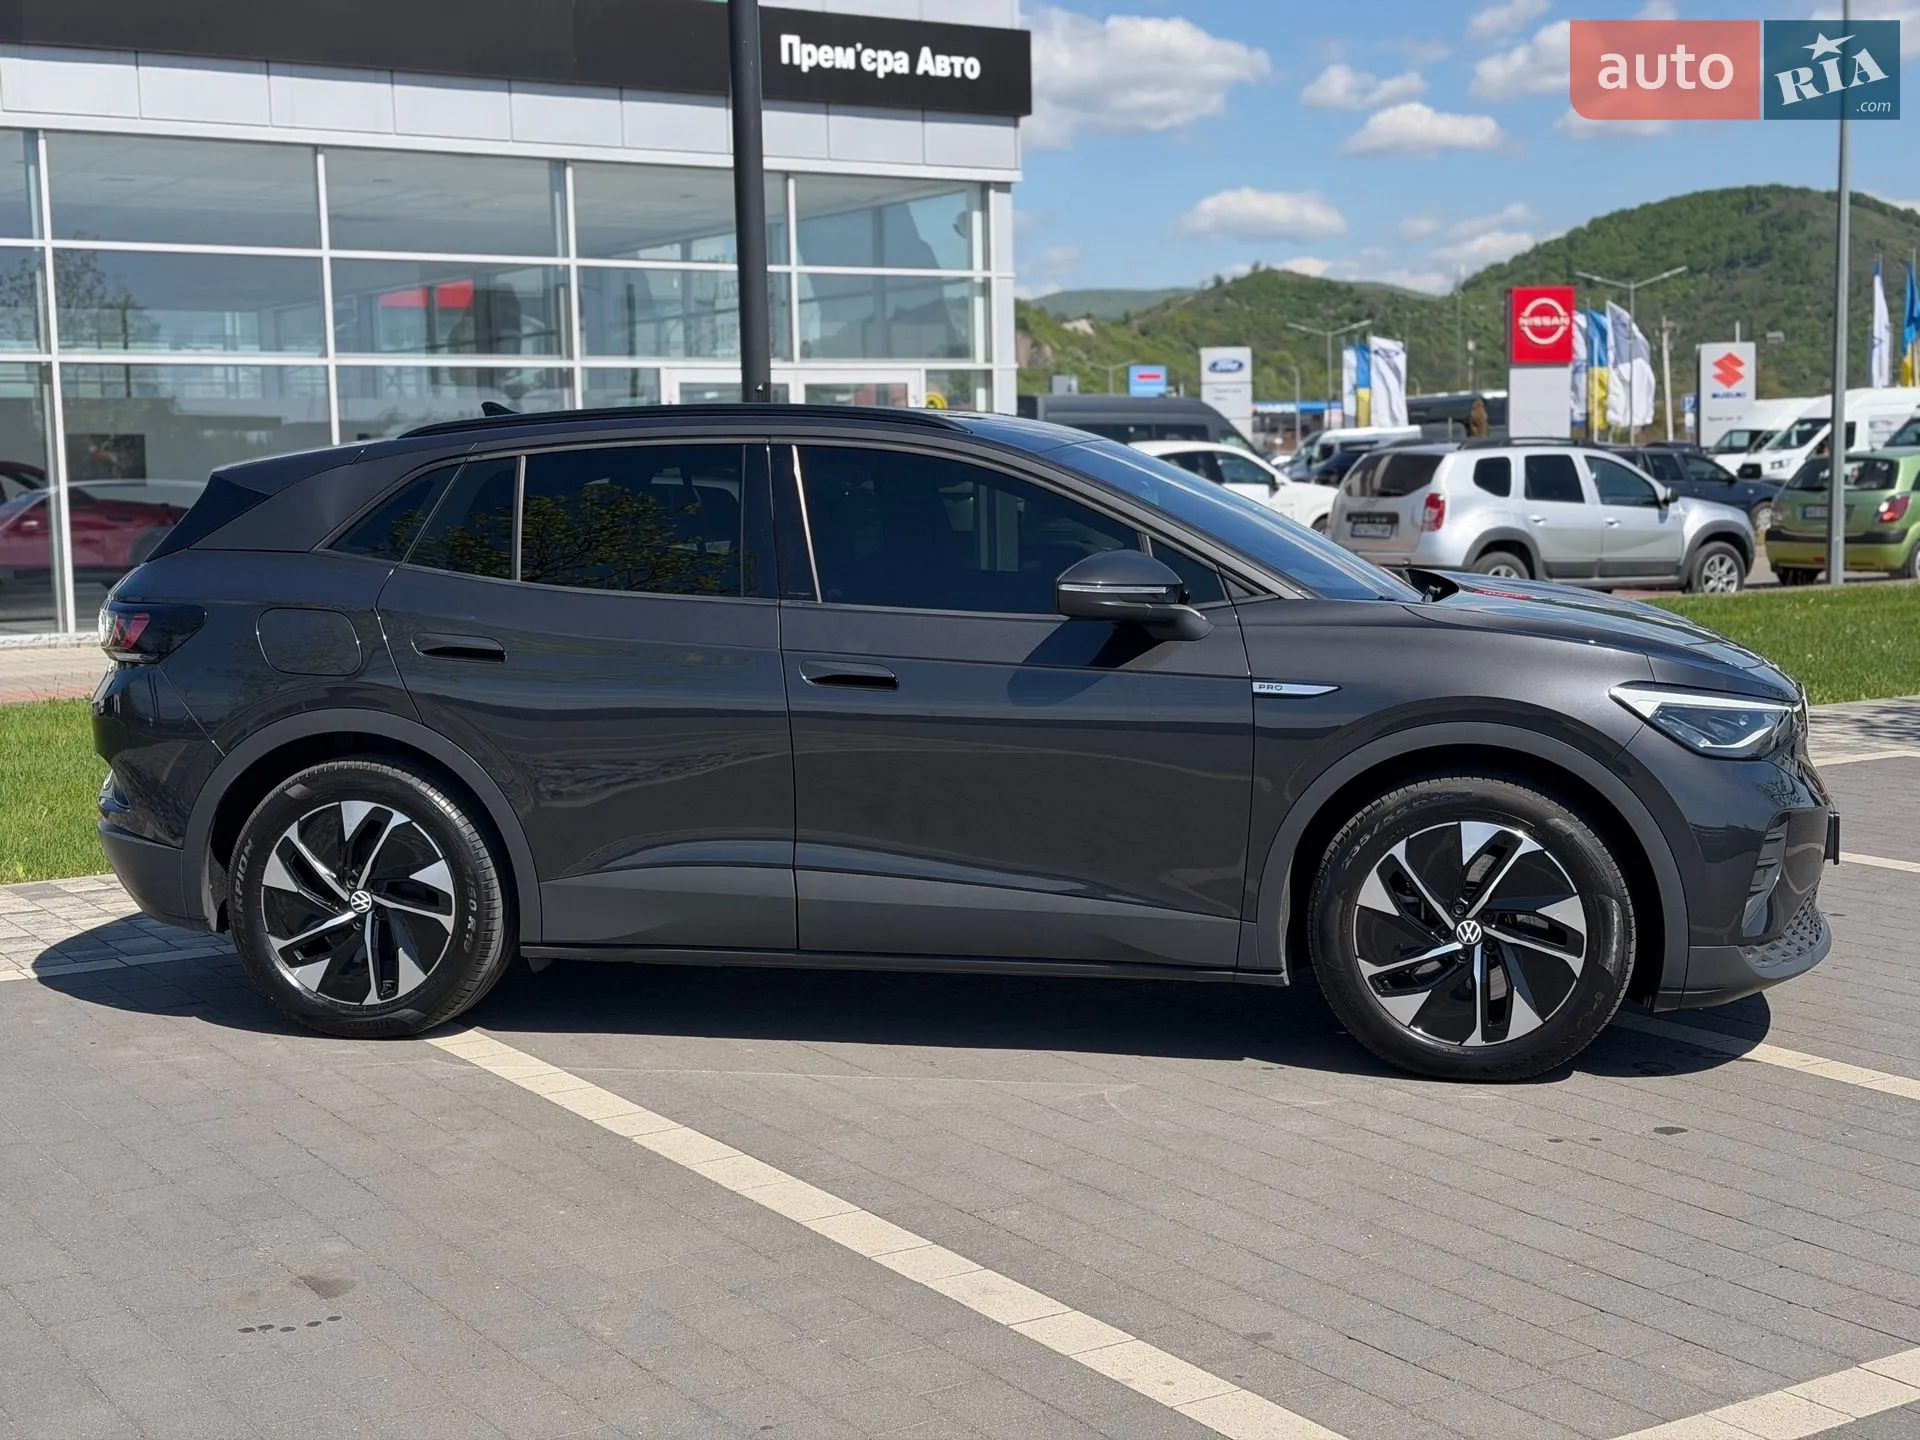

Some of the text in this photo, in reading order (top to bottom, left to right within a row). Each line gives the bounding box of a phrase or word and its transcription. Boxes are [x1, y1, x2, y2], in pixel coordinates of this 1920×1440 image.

[915, 45, 981, 80] Авто
[1518, 315, 1570, 328] NISSAN
[1258, 683, 1283, 691] PRO
